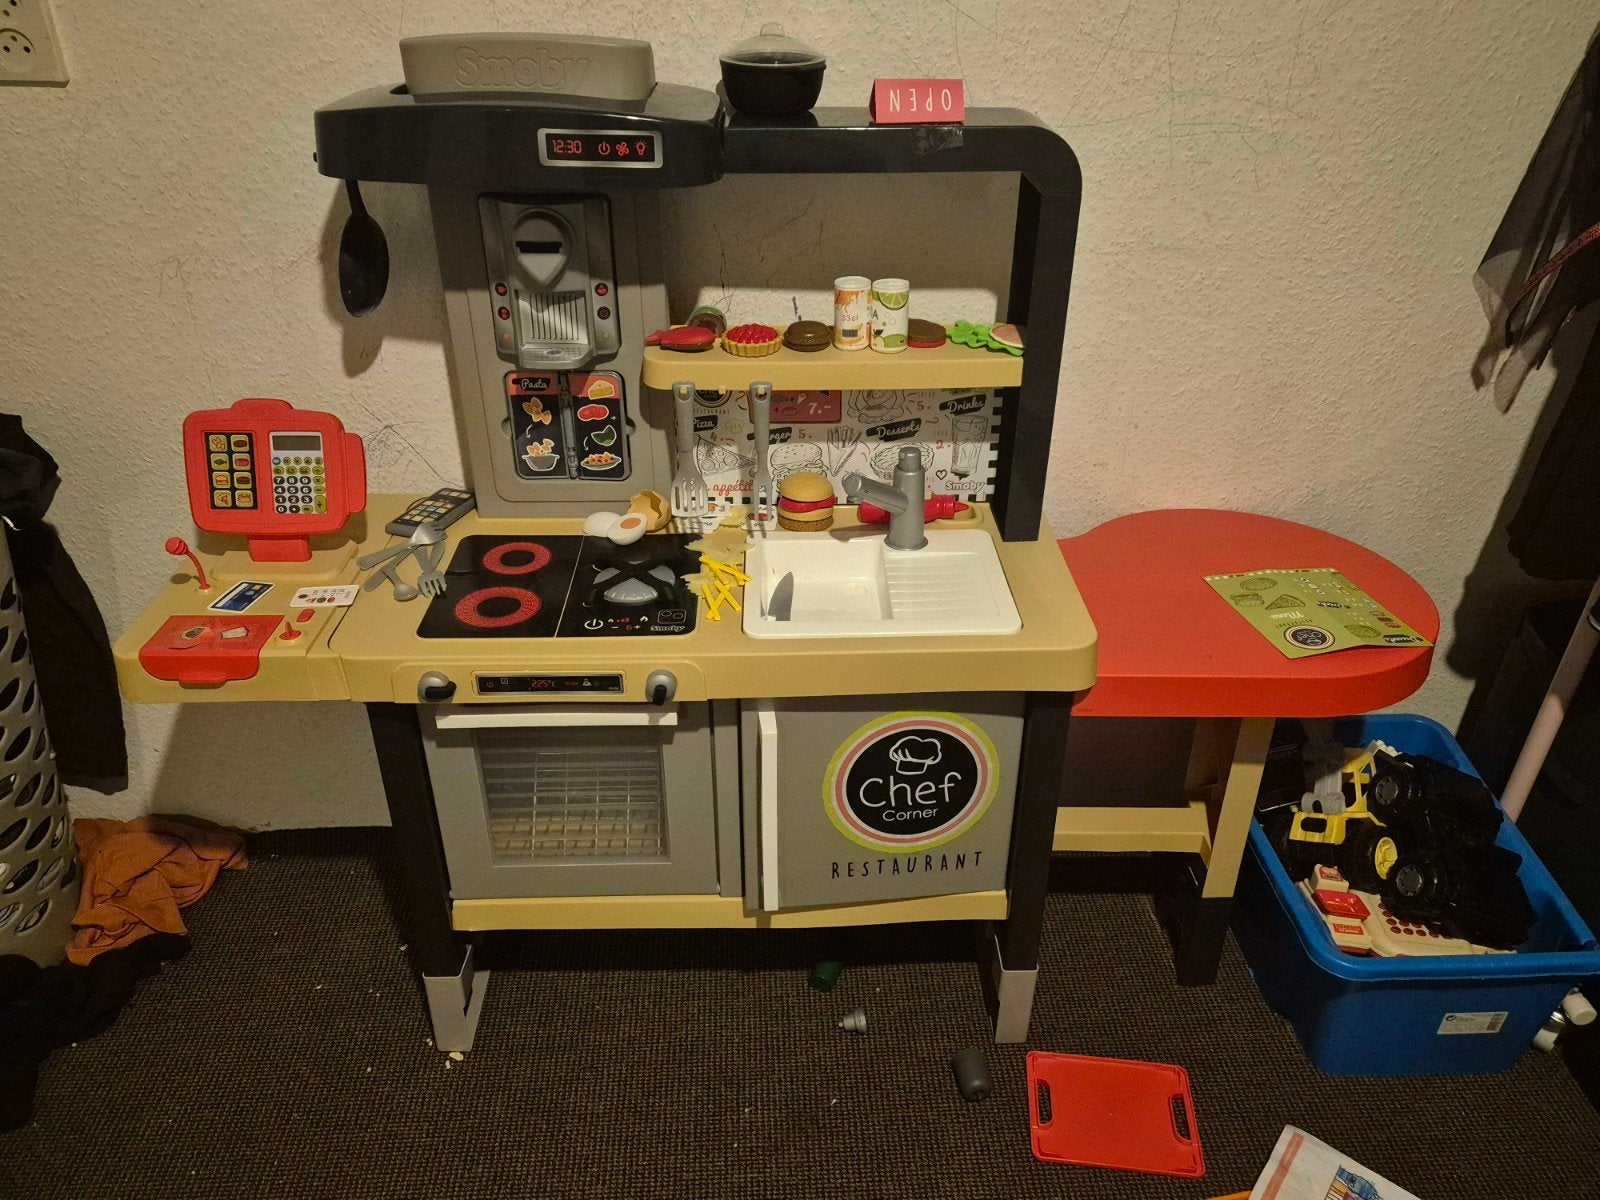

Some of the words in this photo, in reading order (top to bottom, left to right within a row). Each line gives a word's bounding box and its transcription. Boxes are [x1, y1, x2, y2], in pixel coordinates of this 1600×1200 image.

[453, 46, 591, 94] Smoby
[889, 87, 952, 112] OPEN
[551, 139, 583, 154] 12:30
[521, 378, 548, 390] Pasta
[947, 396, 985, 413] Drinks
[876, 420, 921, 437] Desserts
[945, 480, 985, 493] Smoby
[859, 771, 962, 808] Chef
[882, 808, 939, 822] Corner
[831, 851, 983, 880] RESTAURANT
